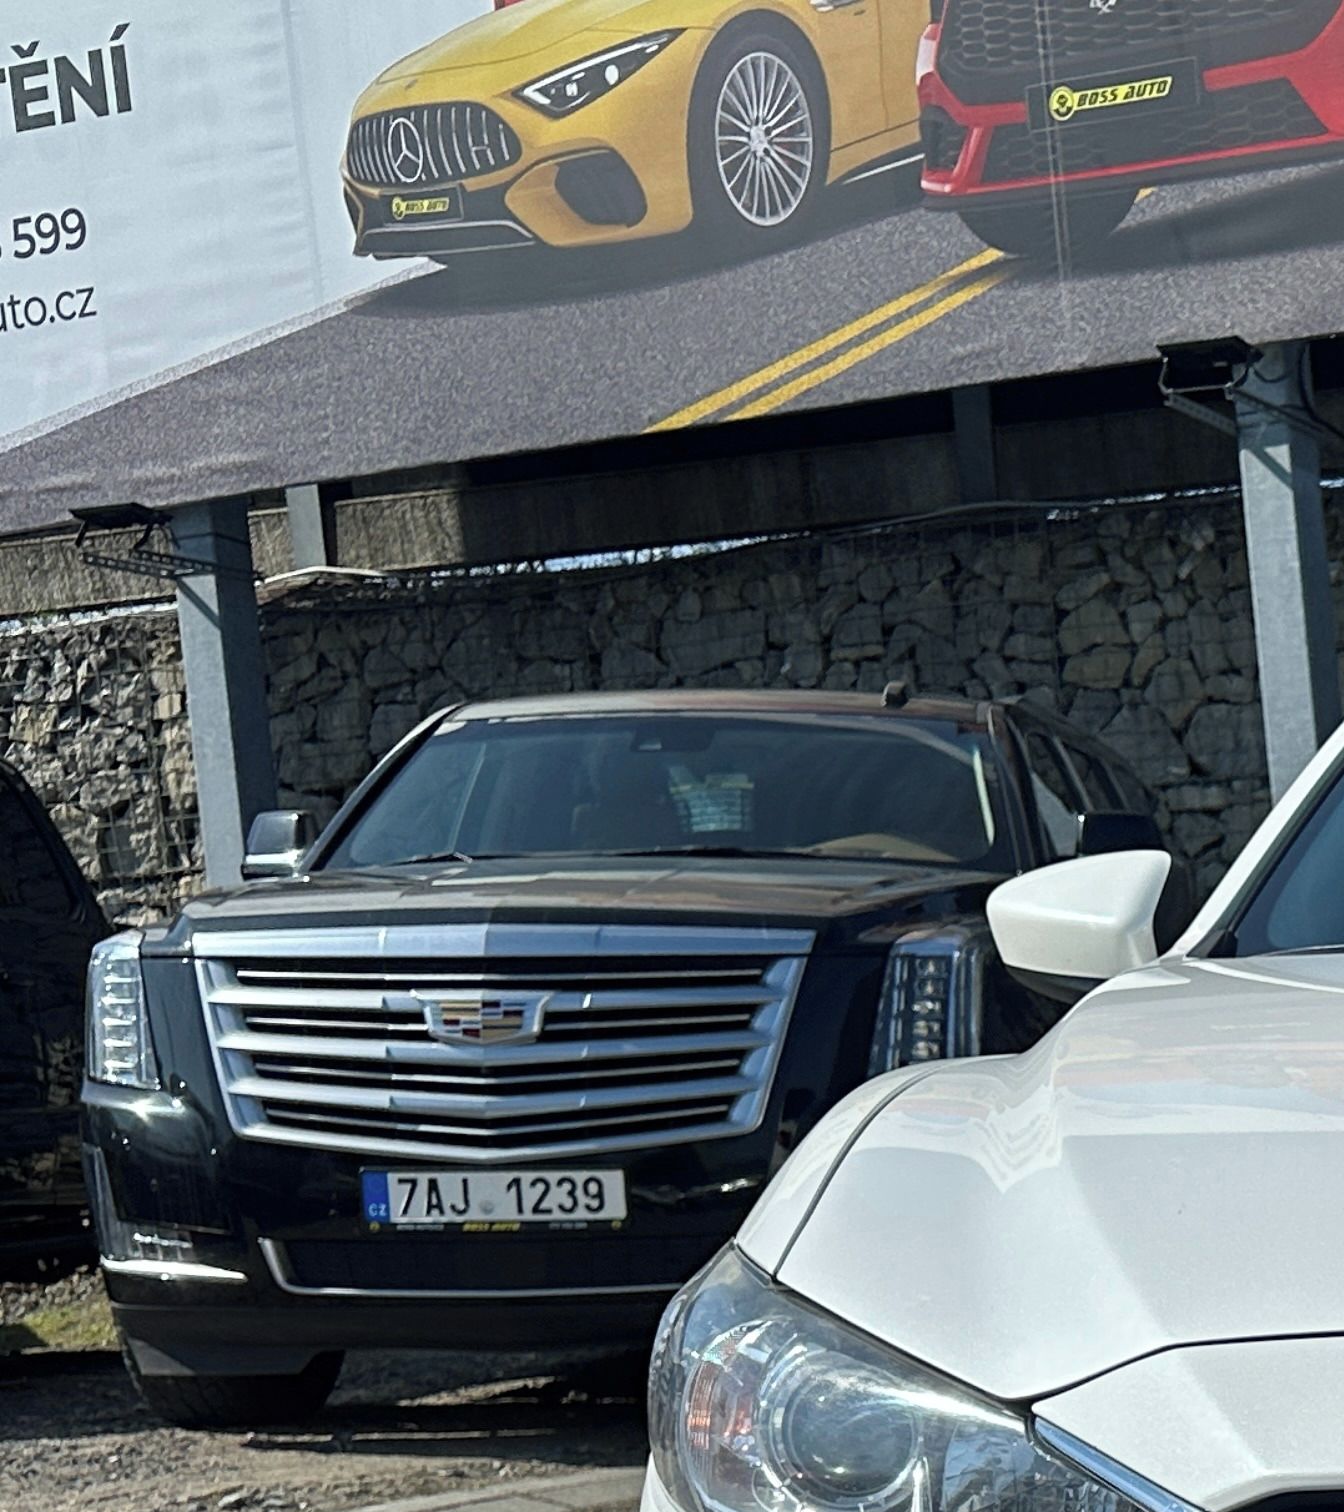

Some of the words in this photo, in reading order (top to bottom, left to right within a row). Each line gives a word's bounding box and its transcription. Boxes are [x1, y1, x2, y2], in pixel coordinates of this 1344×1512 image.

[0, 22, 132, 133] ĚNÍ
[1077, 87, 1119, 107] BOSS
[1122, 79, 1169, 100] AUTO
[13, 208, 87, 259] 599
[368, 1203, 388, 1217] CZ
[397, 1177, 471, 1217] 7AJ
[506, 1176, 606, 1215] 1239
